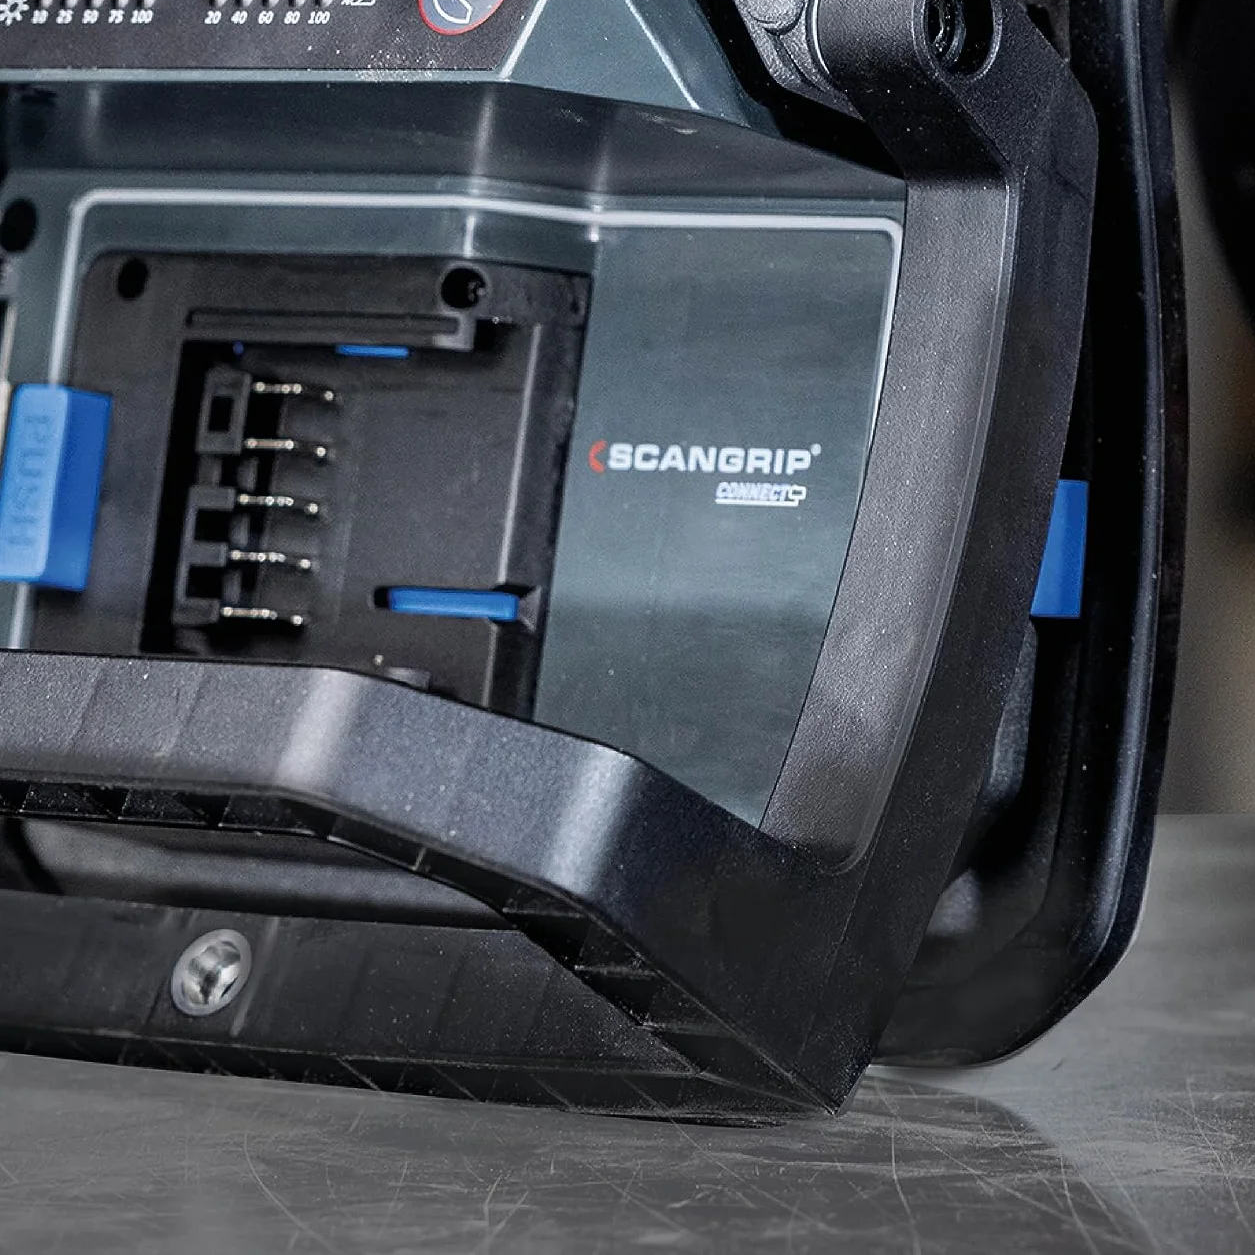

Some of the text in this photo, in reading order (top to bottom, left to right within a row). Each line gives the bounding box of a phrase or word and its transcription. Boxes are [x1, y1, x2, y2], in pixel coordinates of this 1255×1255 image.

[56, 9, 73, 24] 25
[108, 9, 124, 24] 75
[131, 9, 154, 24] 100
[204, 10, 331, 25] 20 40 60 80 100
[607, 442, 812, 475] SCANGRIP
[8, 414, 52, 546] PUSH
[715, 481, 791, 502] CONNECT
